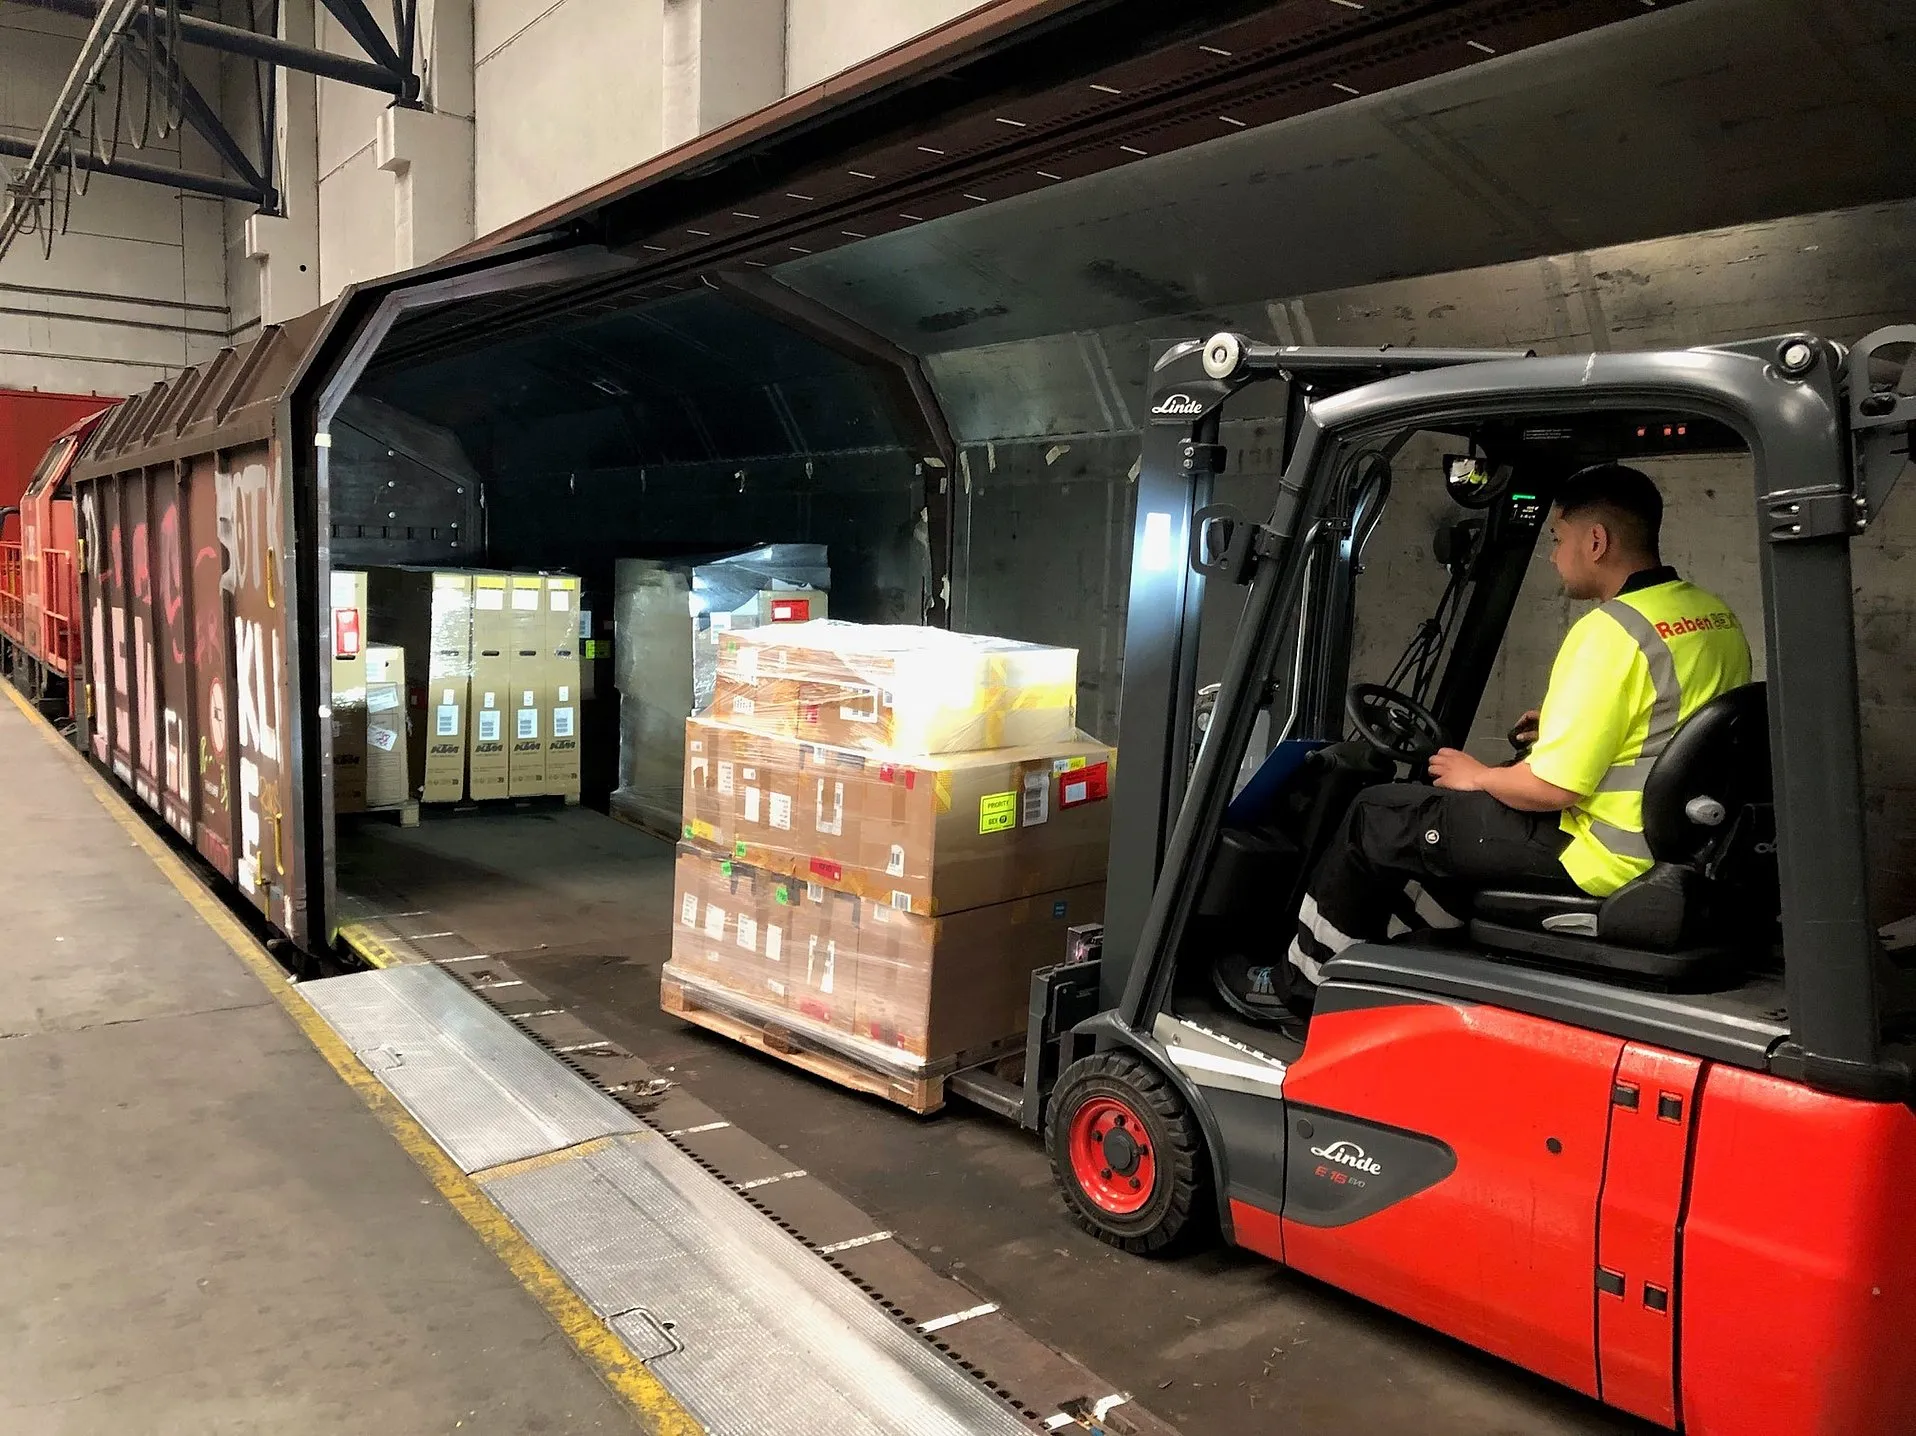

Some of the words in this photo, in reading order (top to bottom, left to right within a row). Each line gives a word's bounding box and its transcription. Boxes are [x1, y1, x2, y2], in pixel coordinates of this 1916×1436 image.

[1151, 393, 1203, 414] Linde
[1655, 615, 1713, 640] Raben
[1310, 1141, 1381, 1175] Linde
[1314, 1165, 1328, 1177] E
